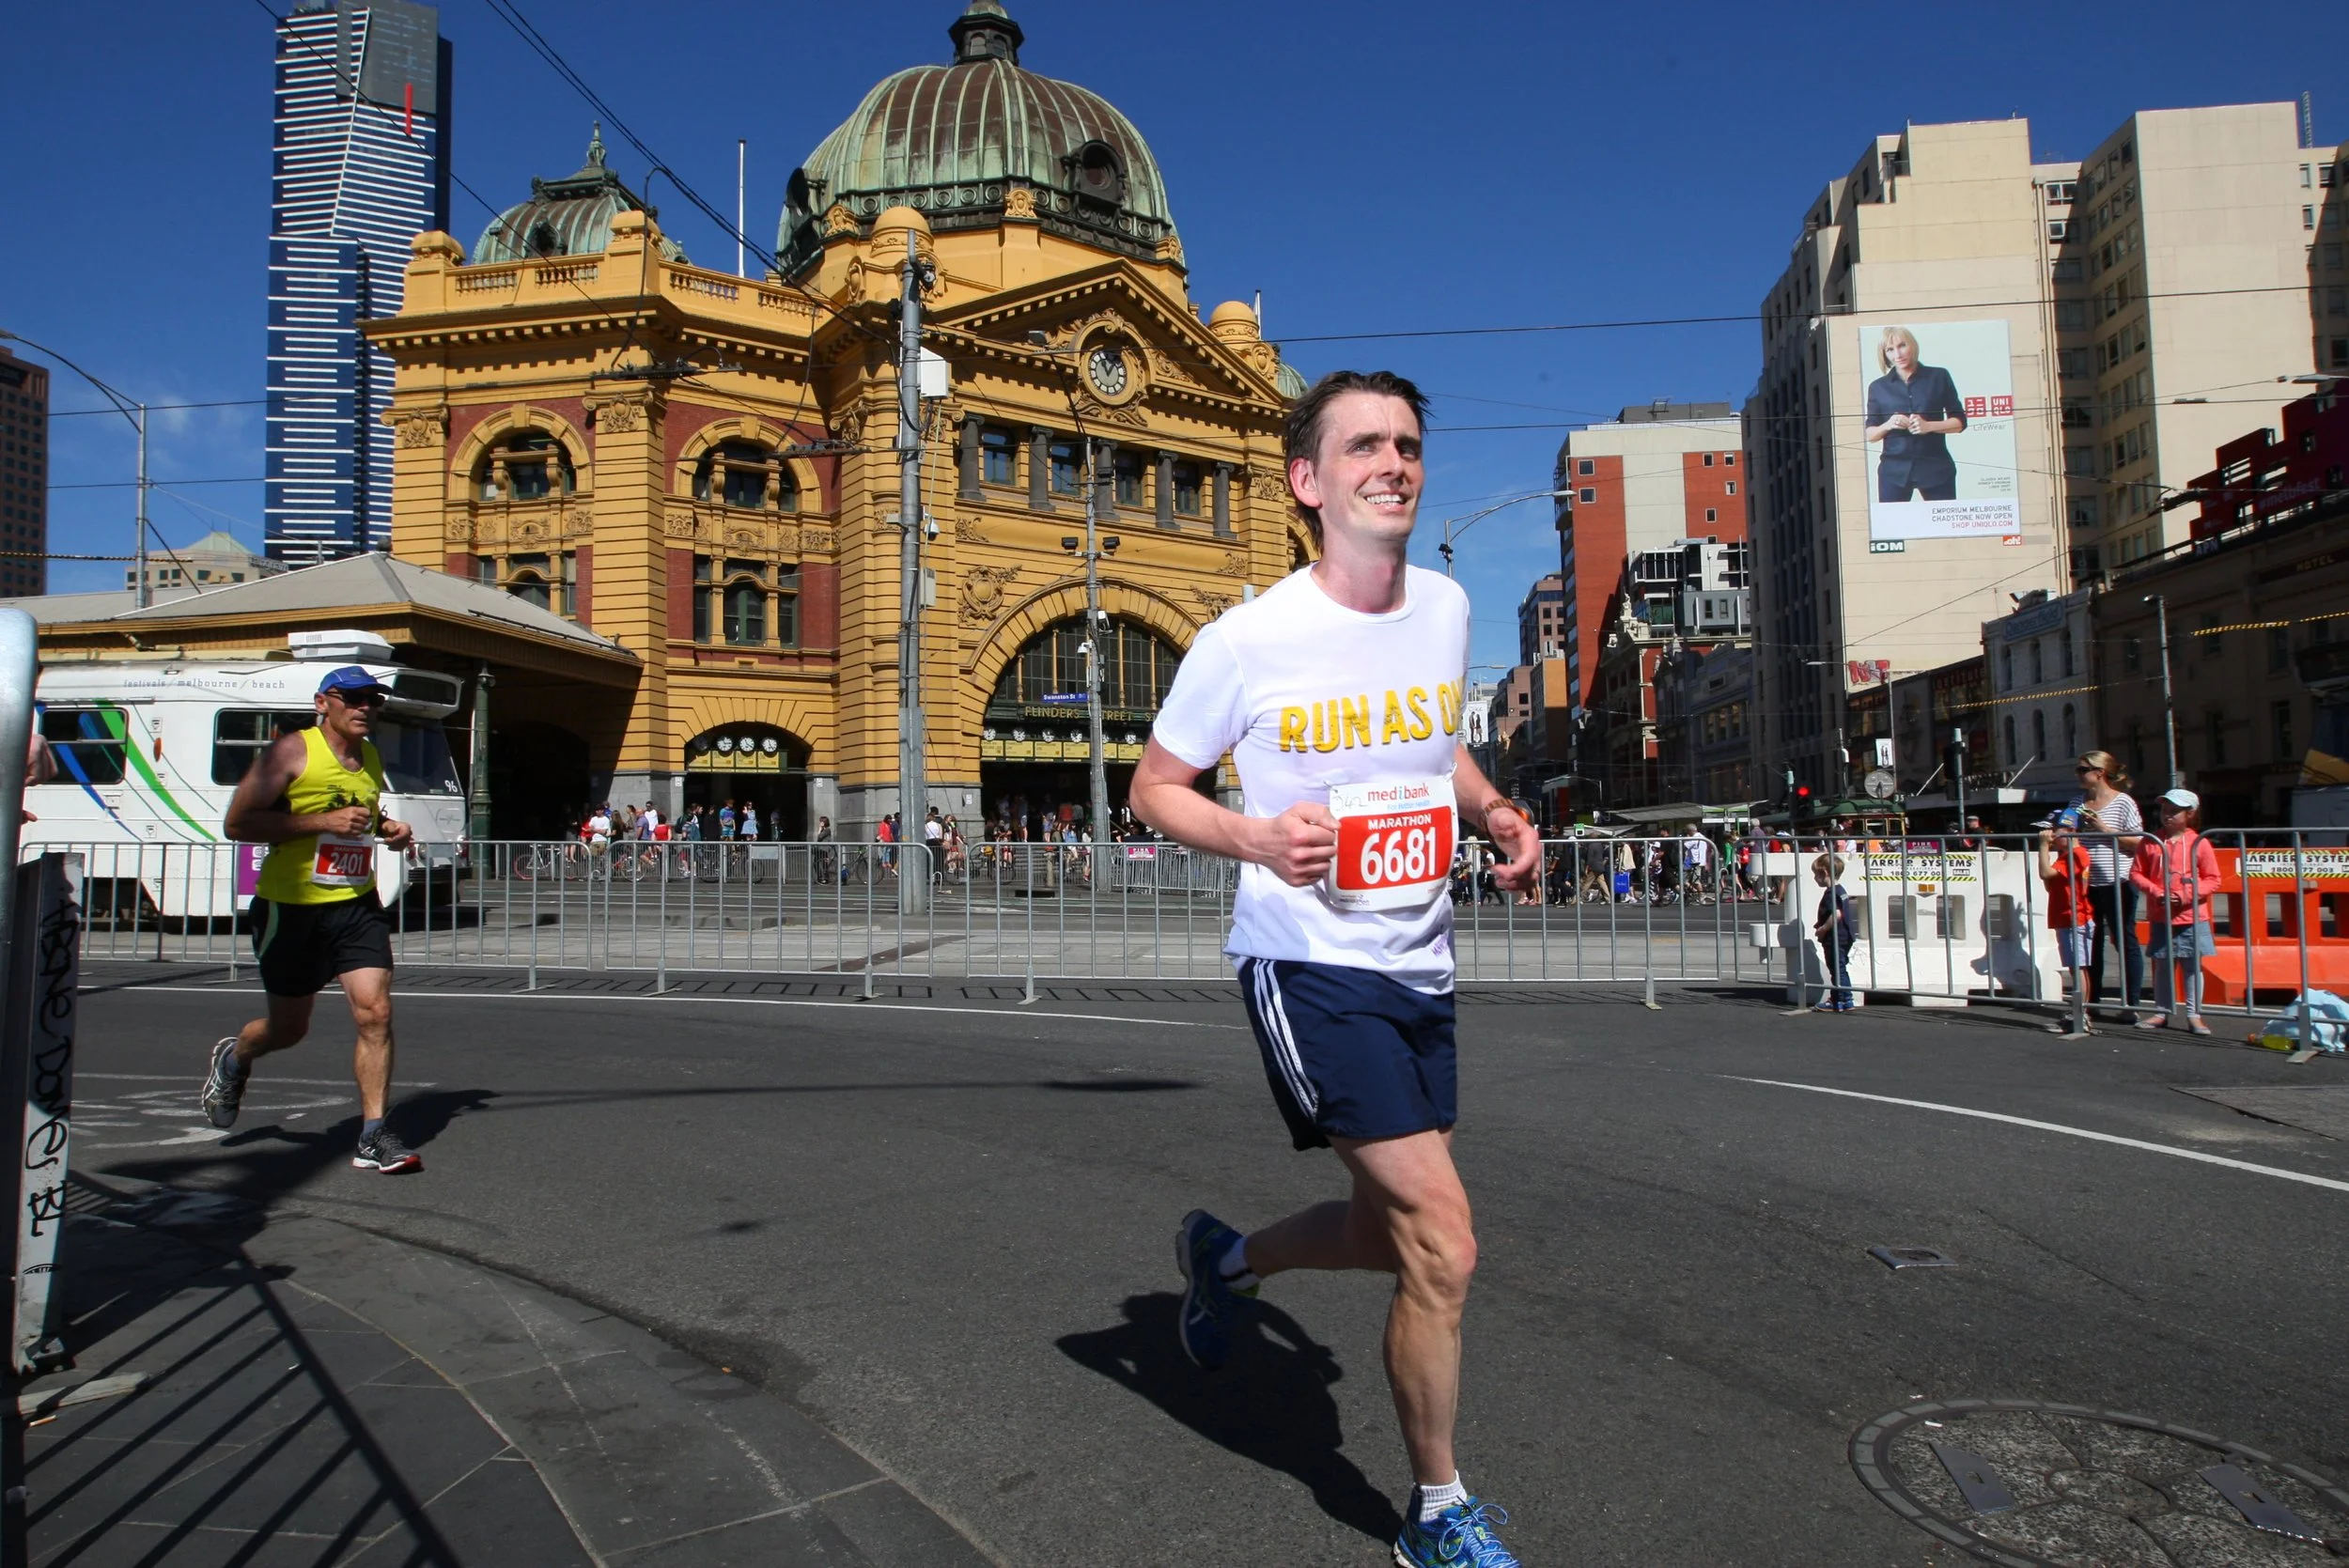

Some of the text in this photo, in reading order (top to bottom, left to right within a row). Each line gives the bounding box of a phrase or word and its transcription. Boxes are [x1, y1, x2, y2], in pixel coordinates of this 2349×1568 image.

[1993, 406, 2011, 415] QLO
[1969, 505, 2012, 513] MELBOURNE
[1932, 514, 1973, 522] CHADSTONE
[124, 677, 286, 689] festivals melbourne beach
[1025, 706, 1081, 720] FLINDERS
[1101, 710, 1132, 722] TREET
[1280, 692, 1372, 753] RUN
[1381, 686, 1434, 745] AS
[444, 779, 459, 793] 96
[1367, 783, 1431, 801] medibank
[1368, 814, 1432, 830] MARATHON
[327, 851, 364, 875] 2401
[1361, 827, 1437, 885] 6681
[1864, 859, 1914, 867] ARRIR
[1921, 859, 1972, 867] SYSEMS
